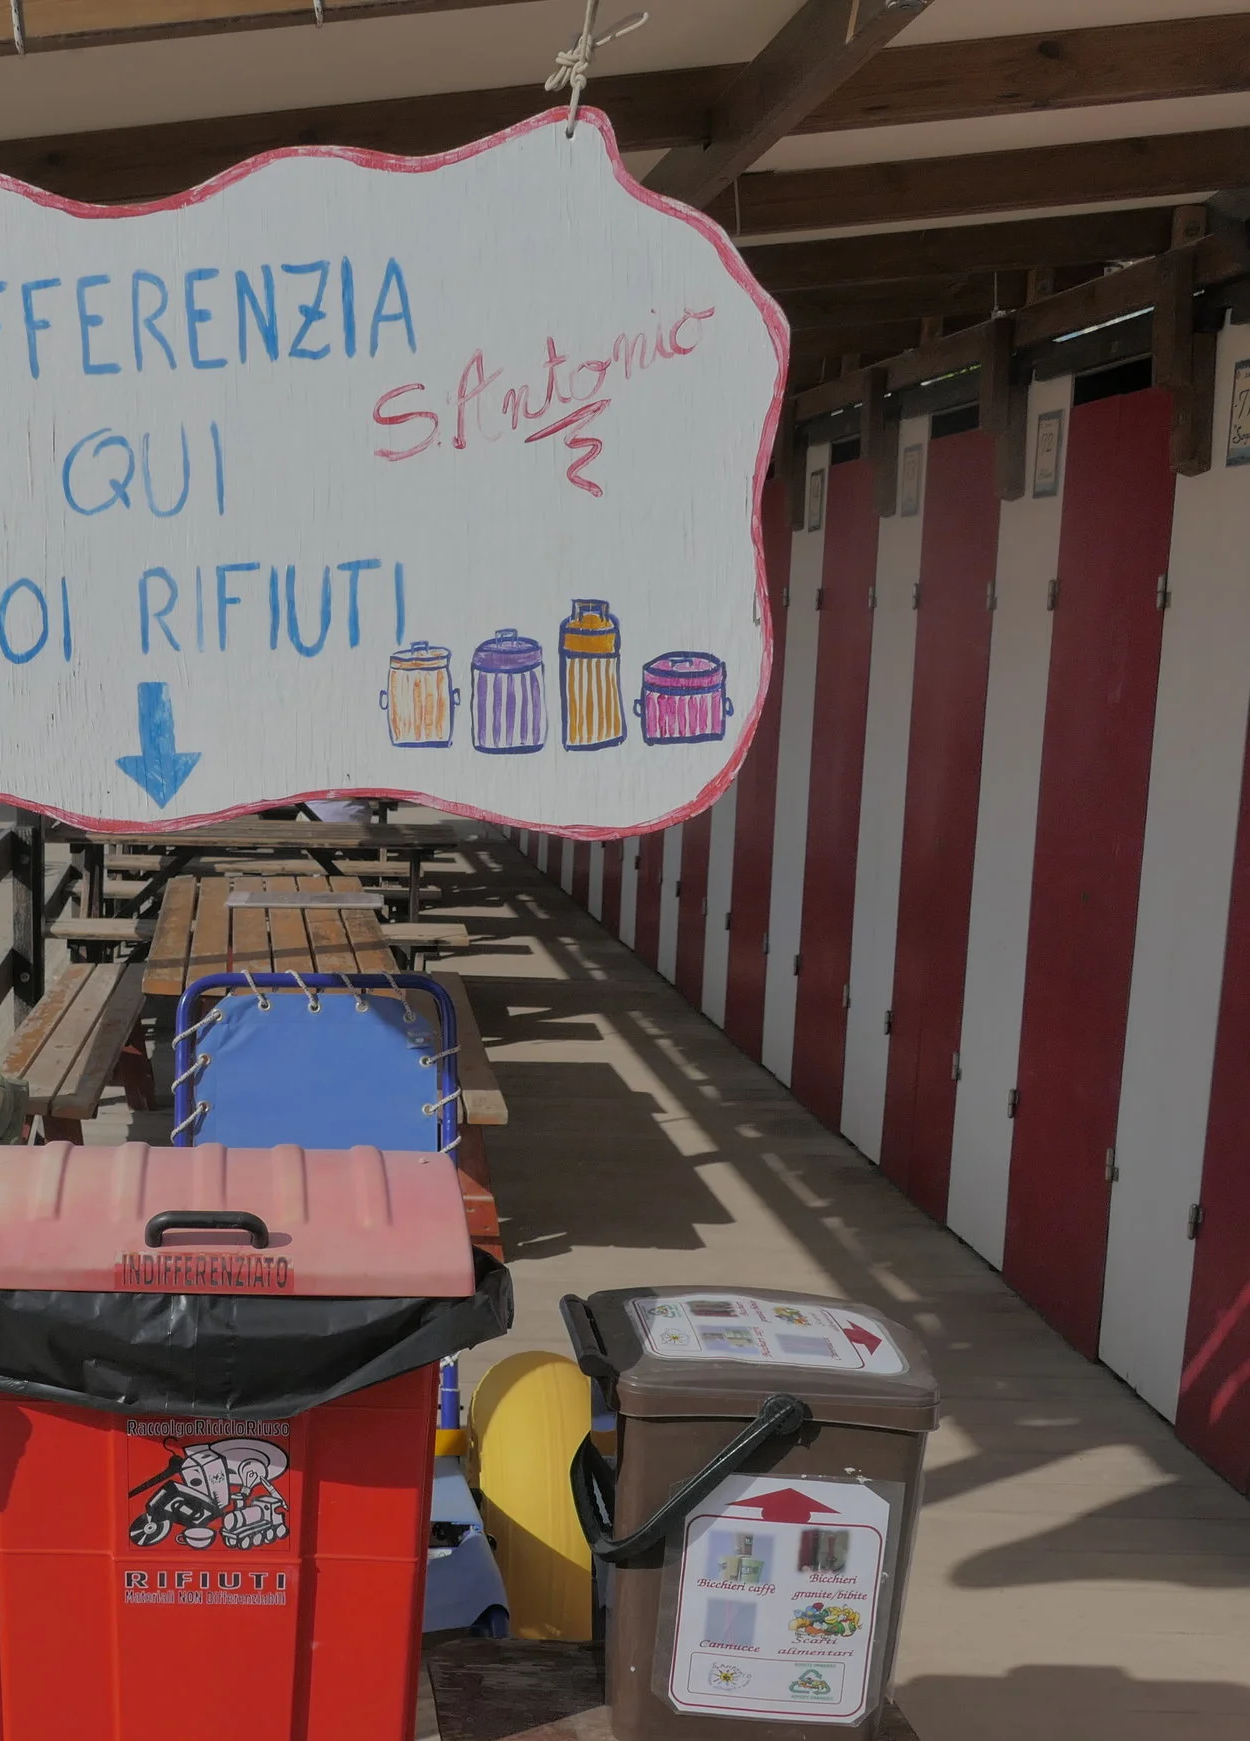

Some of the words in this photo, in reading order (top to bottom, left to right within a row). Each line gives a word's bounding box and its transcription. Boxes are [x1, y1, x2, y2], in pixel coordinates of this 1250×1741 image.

[449, 306, 716, 450] Antonio
[62, 420, 226, 518] QUI
[138, 559, 406, 657] RIFIUTI
[122, 1254, 288, 1288] INDIFFERENZIATO
[127, 1420, 290, 1437] RaccolgoRicicloRiuso
[125, 1571, 286, 1590] RIFIUTI
[697, 1578, 746, 1592] Bicchieri
[809, 1573, 858, 1585] Bicchieri
[179, 1591, 203, 1604] NON
[791, 1590, 868, 1601] granite/bibite
[699, 1640, 761, 1653] Cannucce
[777, 1647, 854, 1657] alimentari
